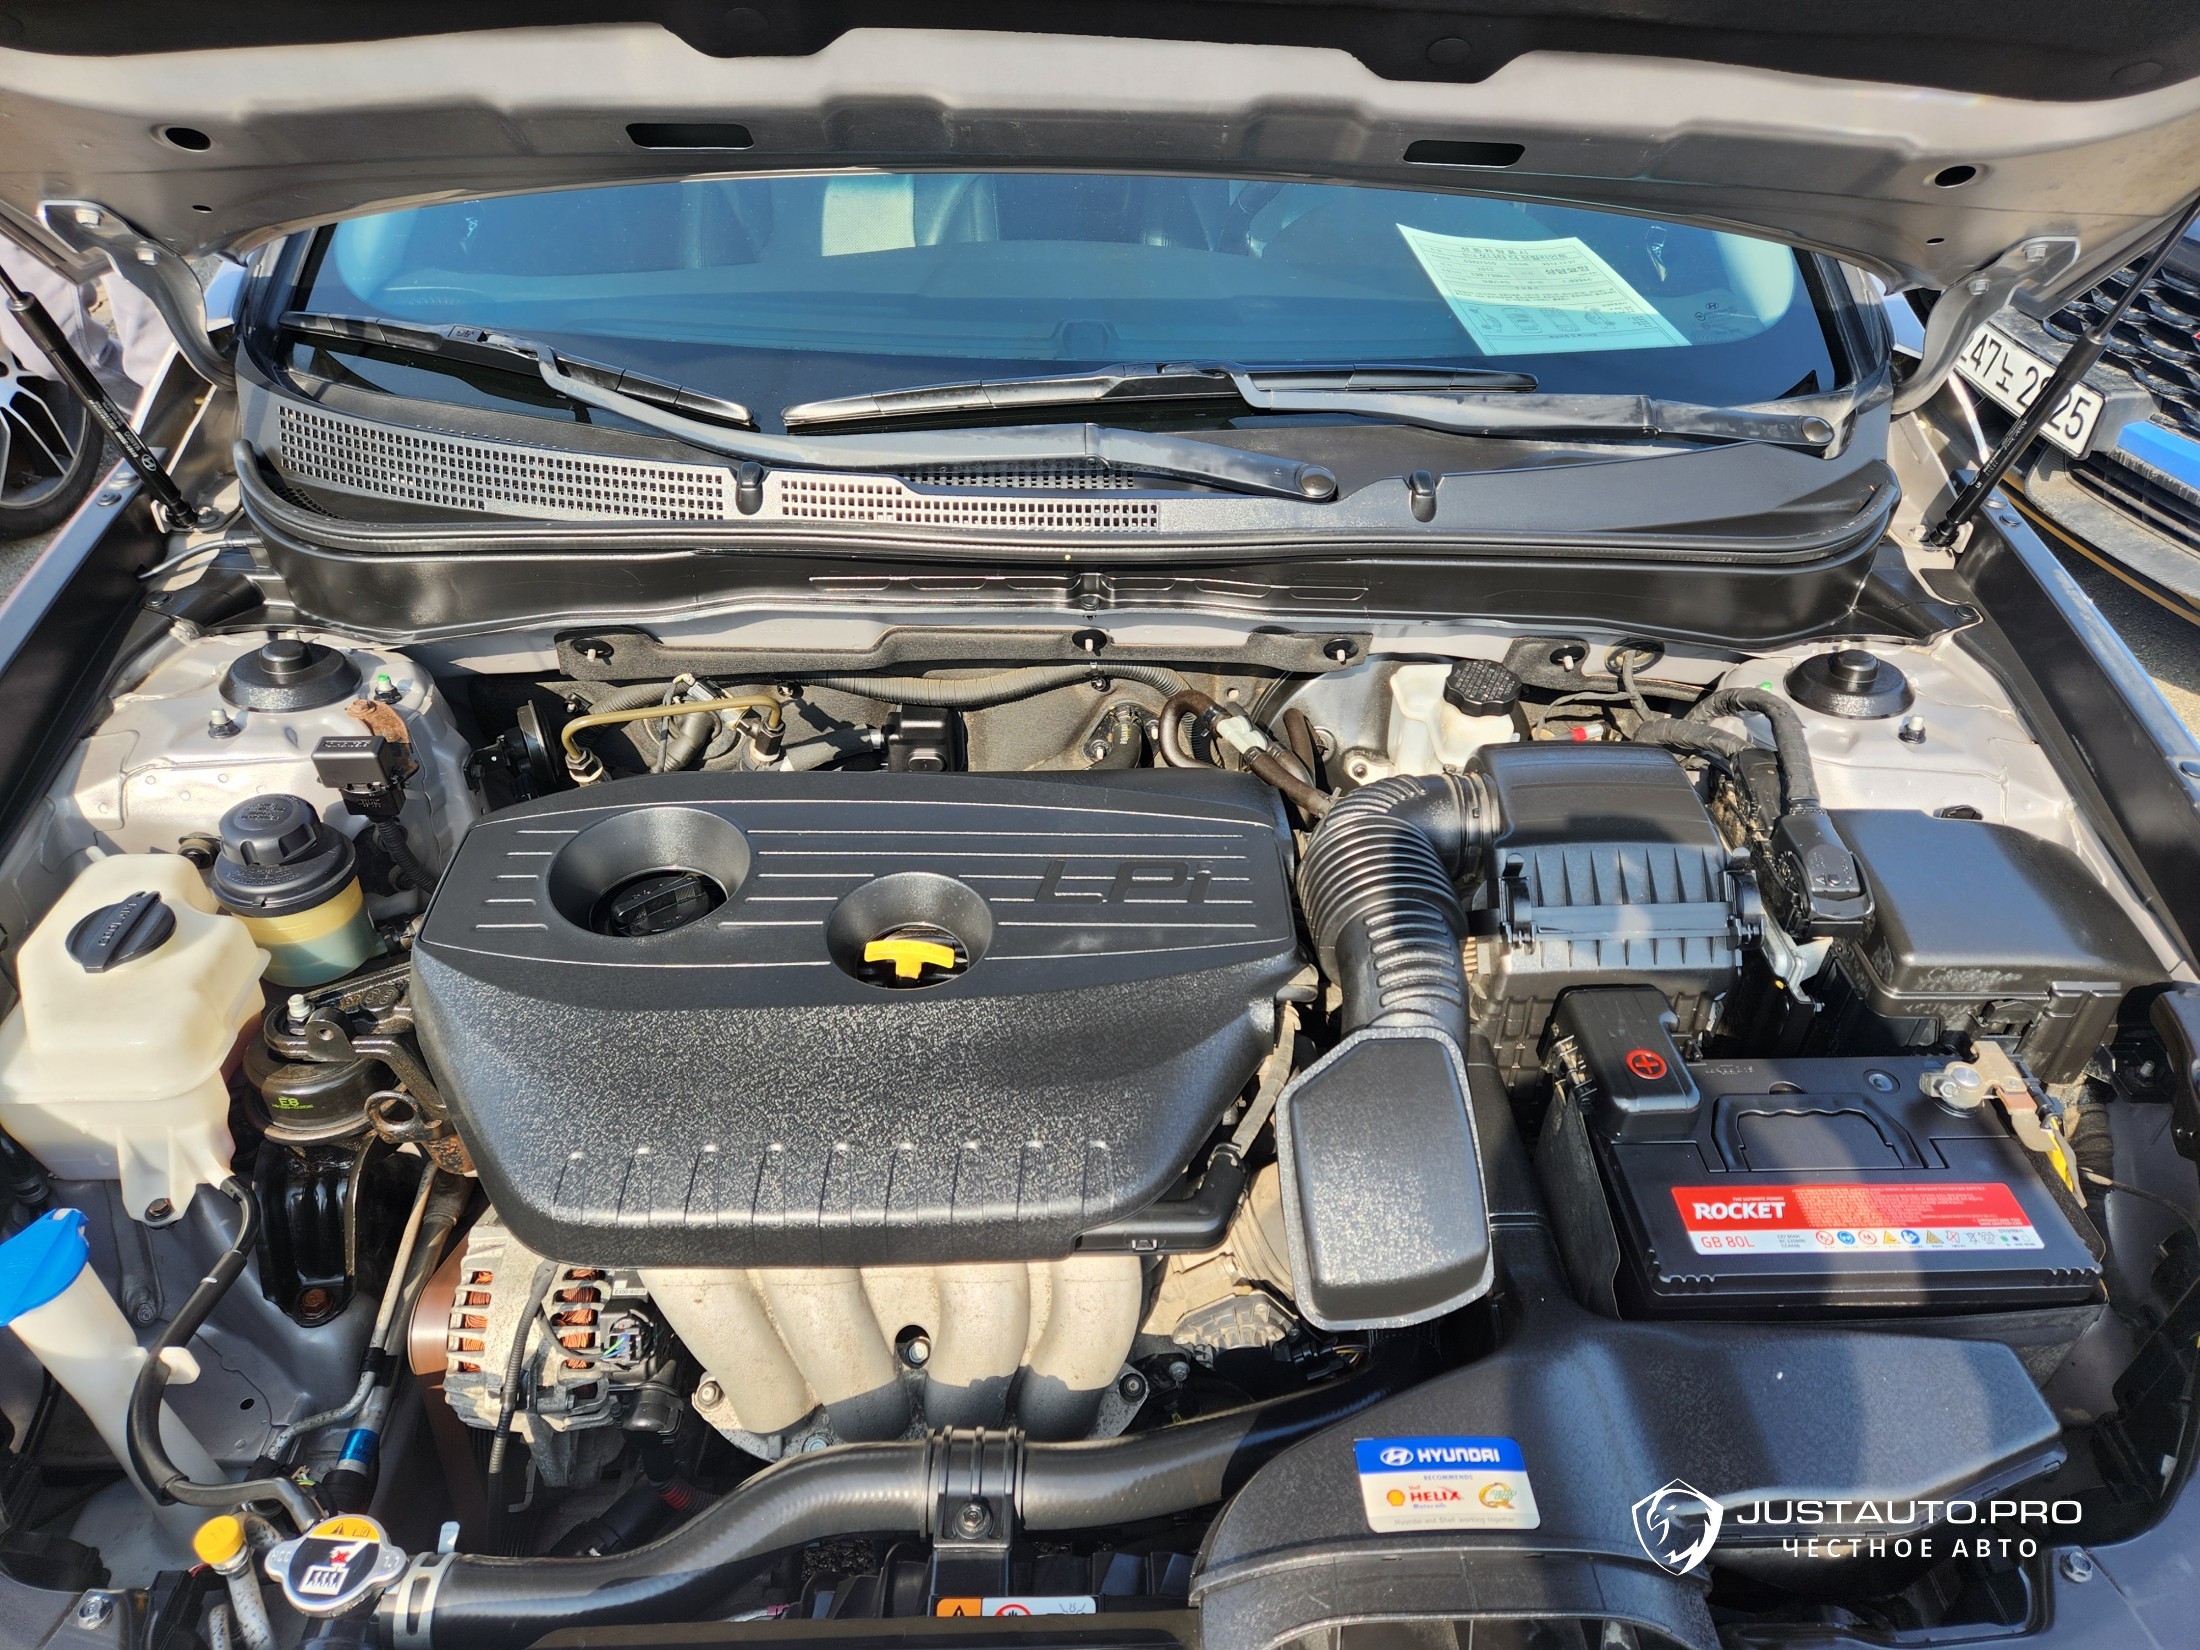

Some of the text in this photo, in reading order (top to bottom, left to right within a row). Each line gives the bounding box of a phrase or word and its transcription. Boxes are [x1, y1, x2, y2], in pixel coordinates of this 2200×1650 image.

[1960, 333, 2013, 393] 47노
[2016, 365, 2092, 440] 225
[1034, 860, 1216, 904] LPi
[1692, 1202, 1786, 1220] ROCKET
[1701, 1236, 1755, 1249] GB 80L
[1416, 1447, 1501, 1464] HYUNDAI
[1410, 1487, 1462, 1503] HELIX
[1394, 1517, 1422, 1526] Hyundai
[1439, 1516, 1456, 1524] Shell
[1459, 1516, 1485, 1525] working
[383, 1555, 400, 1568] 1.1
